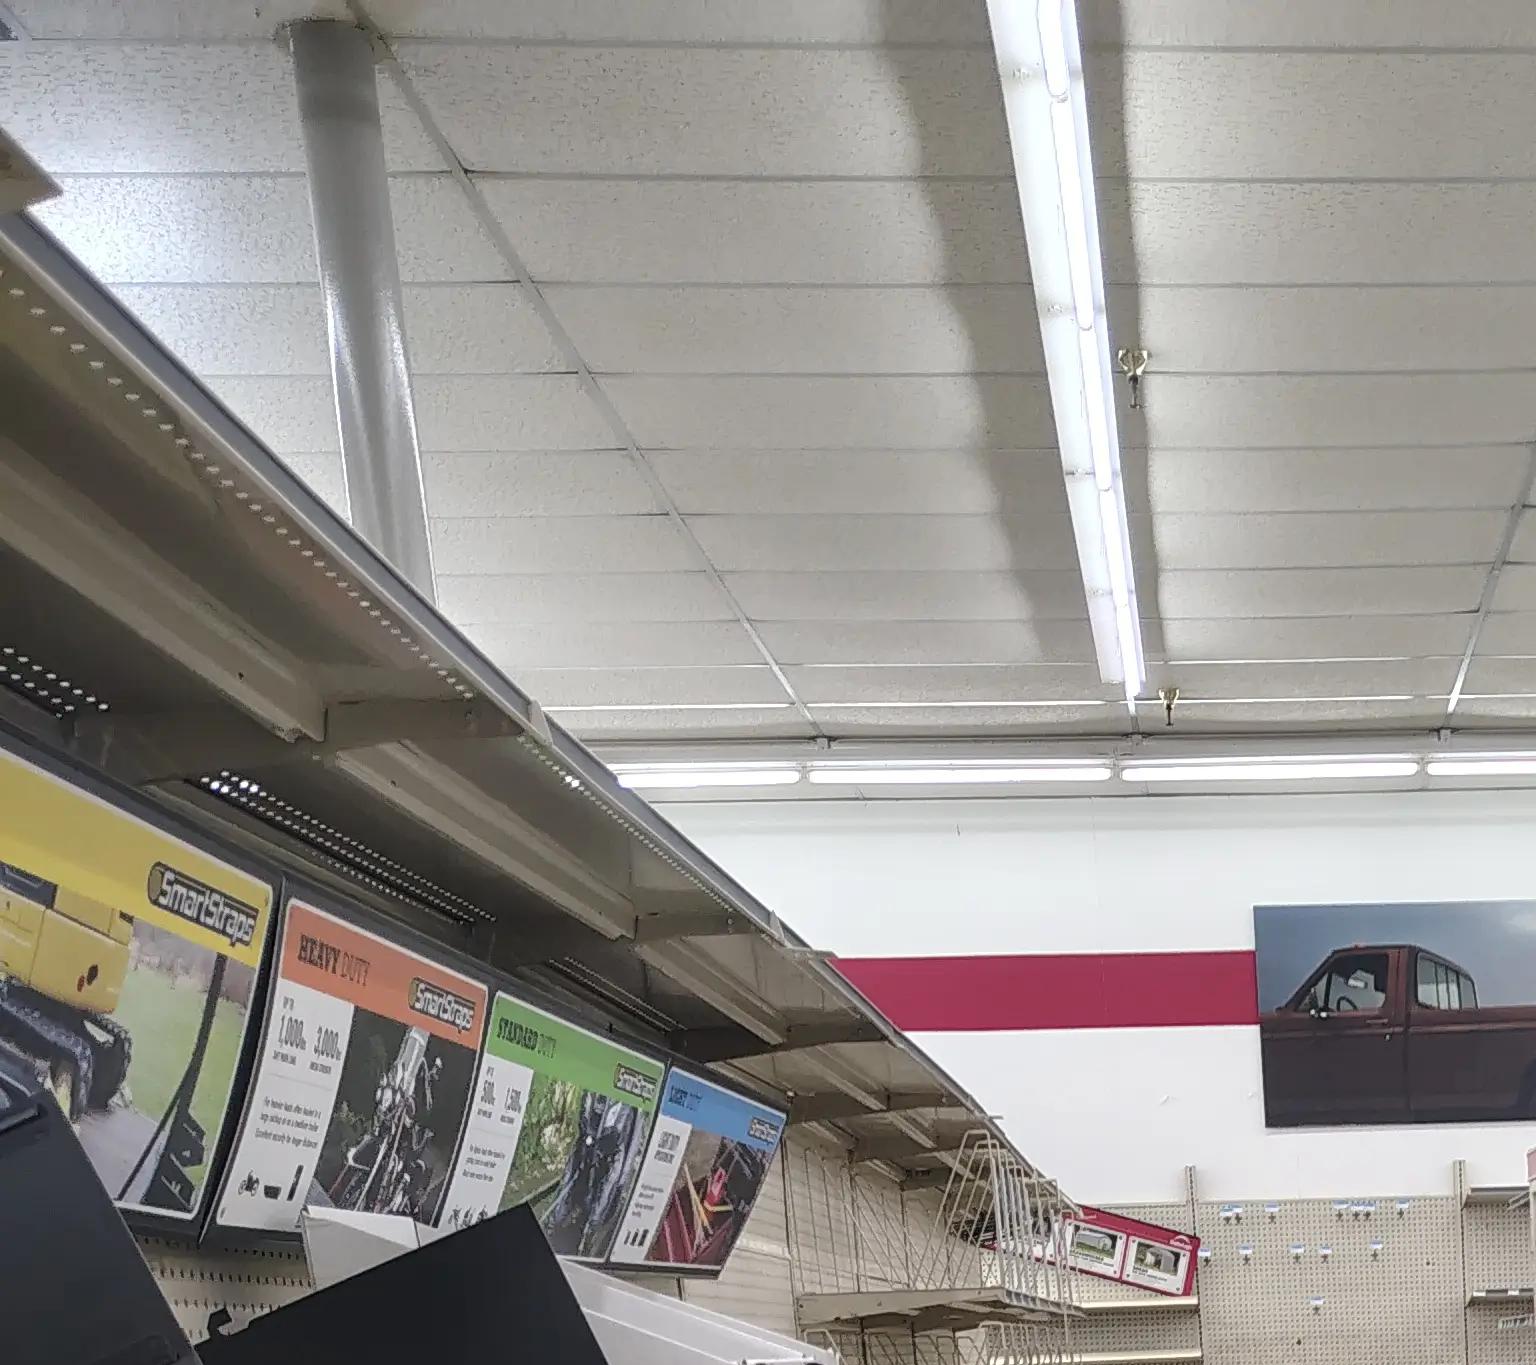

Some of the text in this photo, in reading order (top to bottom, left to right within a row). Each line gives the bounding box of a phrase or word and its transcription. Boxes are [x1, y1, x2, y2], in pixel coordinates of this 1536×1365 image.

[157, 869, 255, 944] SmartStraps
[298, 934, 342, 977] HEAVY
[414, 982, 475, 1031] SmartStraps
[497, 1016, 540, 1051] STANDARD
